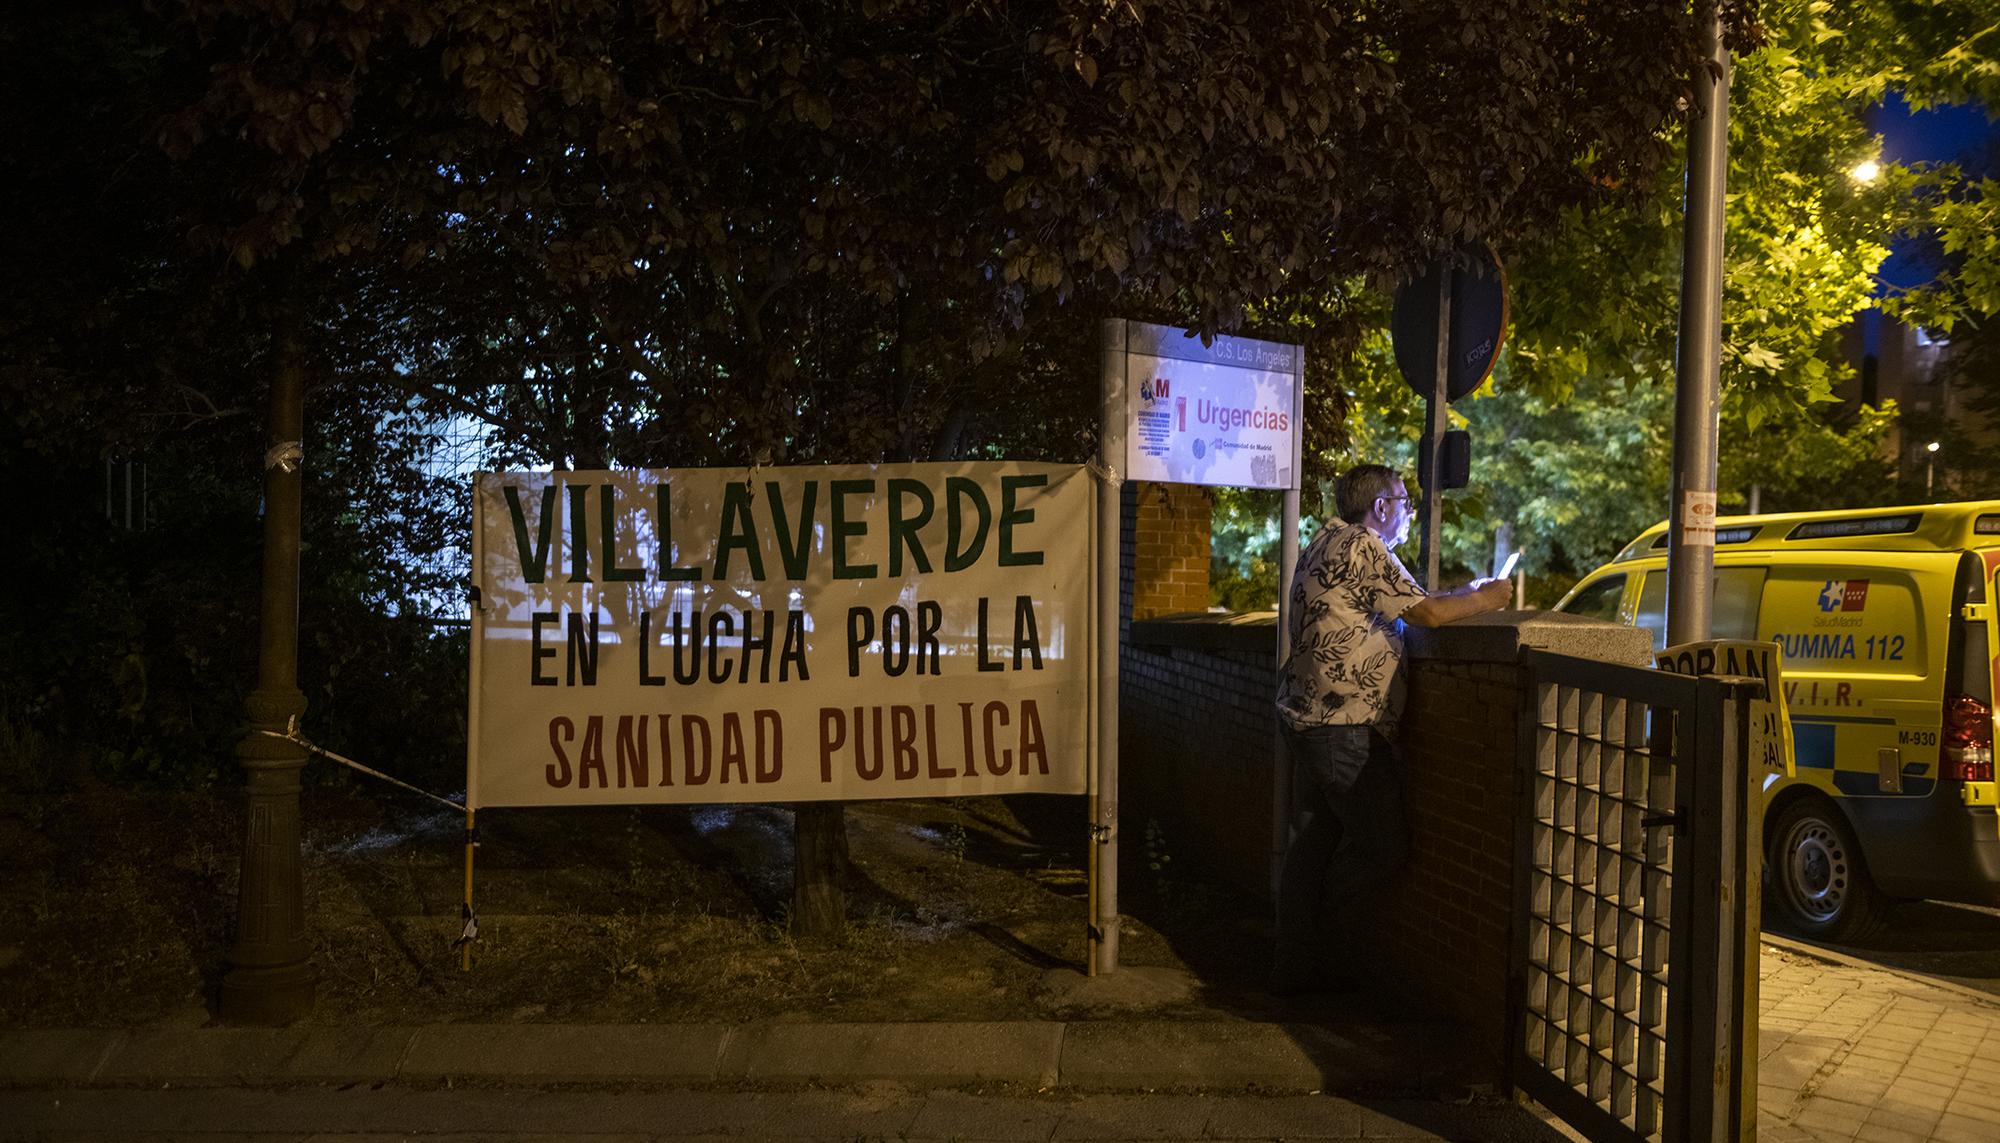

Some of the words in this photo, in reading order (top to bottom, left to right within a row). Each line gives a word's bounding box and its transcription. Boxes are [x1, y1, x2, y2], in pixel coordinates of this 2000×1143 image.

[1216, 341, 1234, 359] C.S.
[1237, 344, 1253, 362] Los
[1197, 398, 1288, 432] Urgencias
[503, 474, 1048, 583] VILLAVERDE
[531, 612, 598, 687] EN
[639, 609, 810, 686] LUCHA
[848, 600, 941, 677] POR
[977, 595, 1044, 672] LA
[1772, 633, 1855, 660] SUMMA
[1866, 635, 1905, 660] 112
[545, 709, 783, 788] SANIDAD
[819, 699, 1049, 782] PUBLICA
[1899, 731, 1936, 746] M-930
